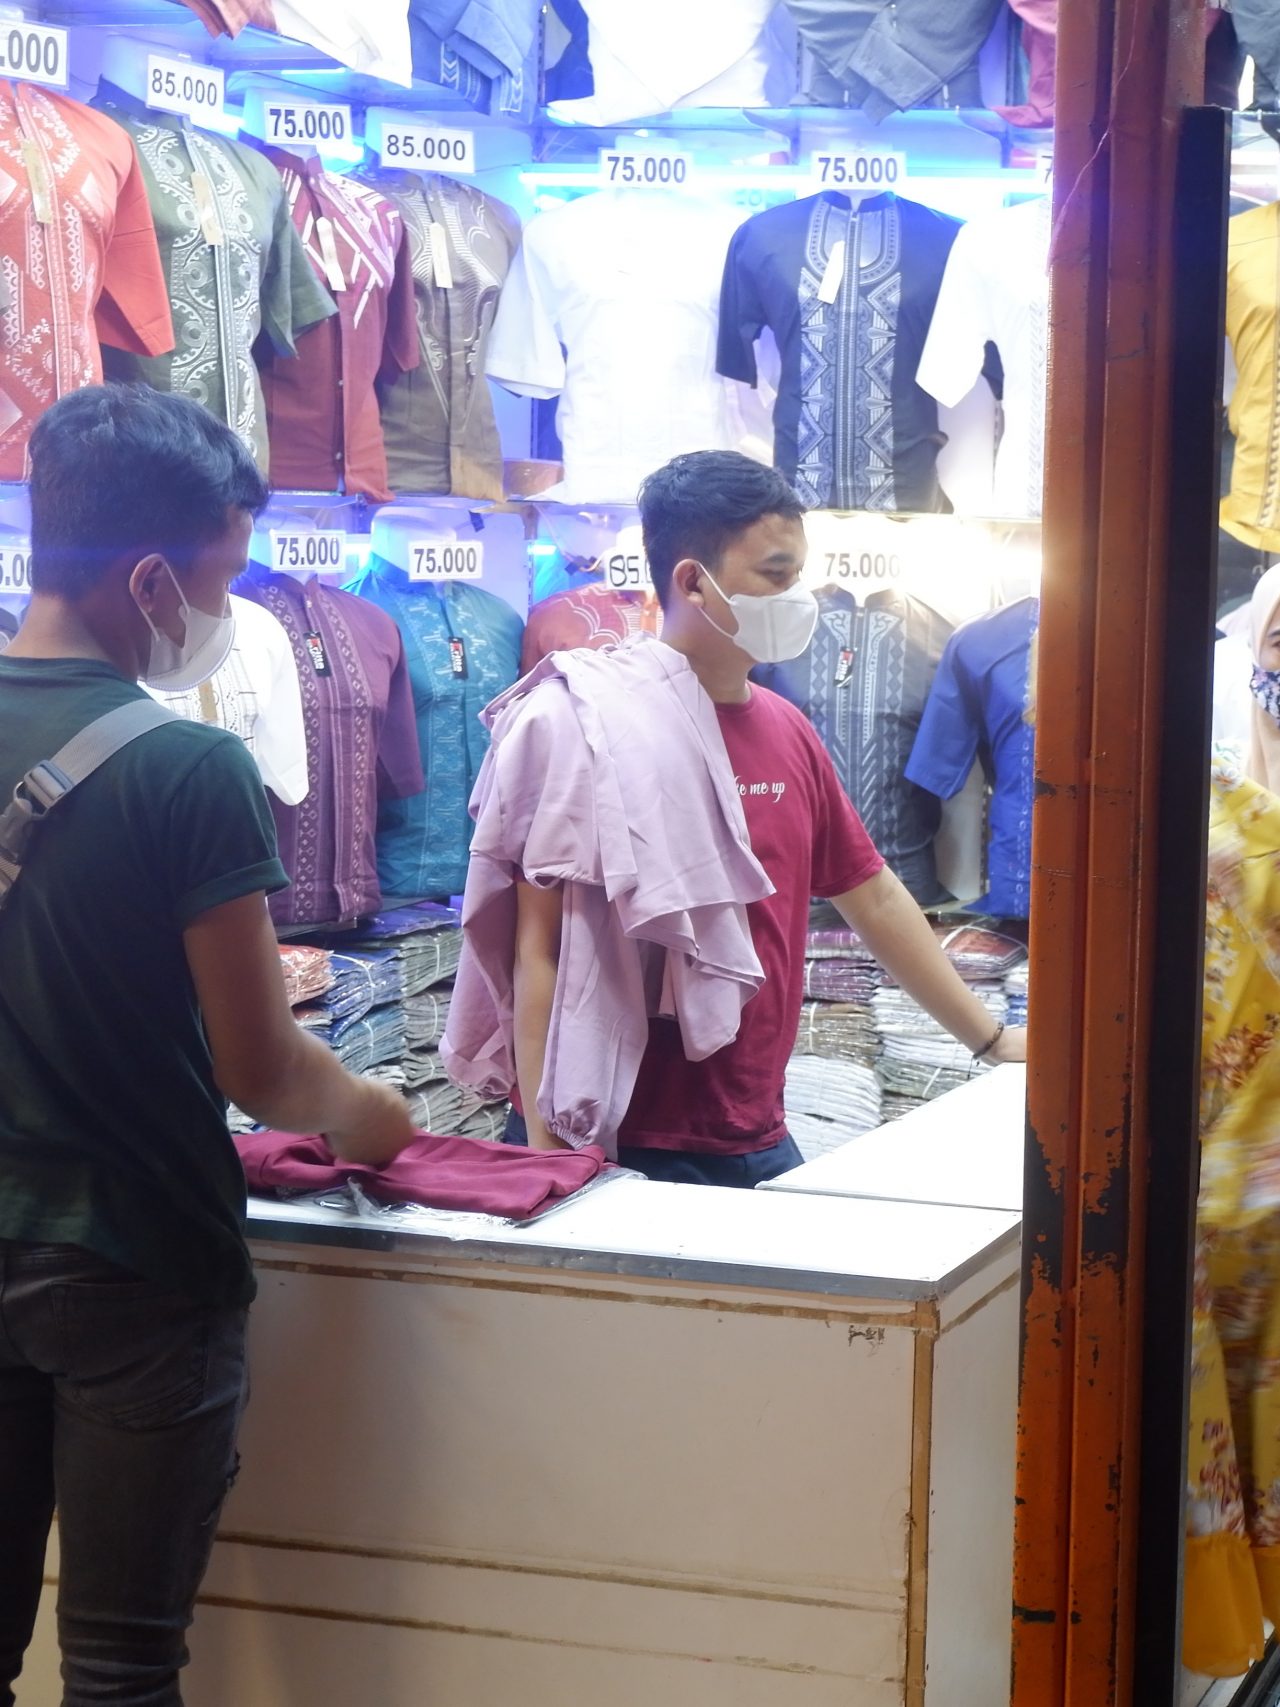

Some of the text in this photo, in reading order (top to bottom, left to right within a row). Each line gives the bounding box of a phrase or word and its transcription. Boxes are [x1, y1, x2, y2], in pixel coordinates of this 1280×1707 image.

[151, 68, 218, 107] 85.000
[269, 108, 345, 139] 75.000
[386, 134, 466, 161] 85.000
[606, 156, 686, 183] 75.000
[818, 157, 898, 183] 75.000
[277, 537, 340, 566] 75.000
[413, 547, 477, 573] 75.000
[824, 552, 900, 578] 75.000
[750, 782, 769, 795] me
[771, 782, 785, 803] up
